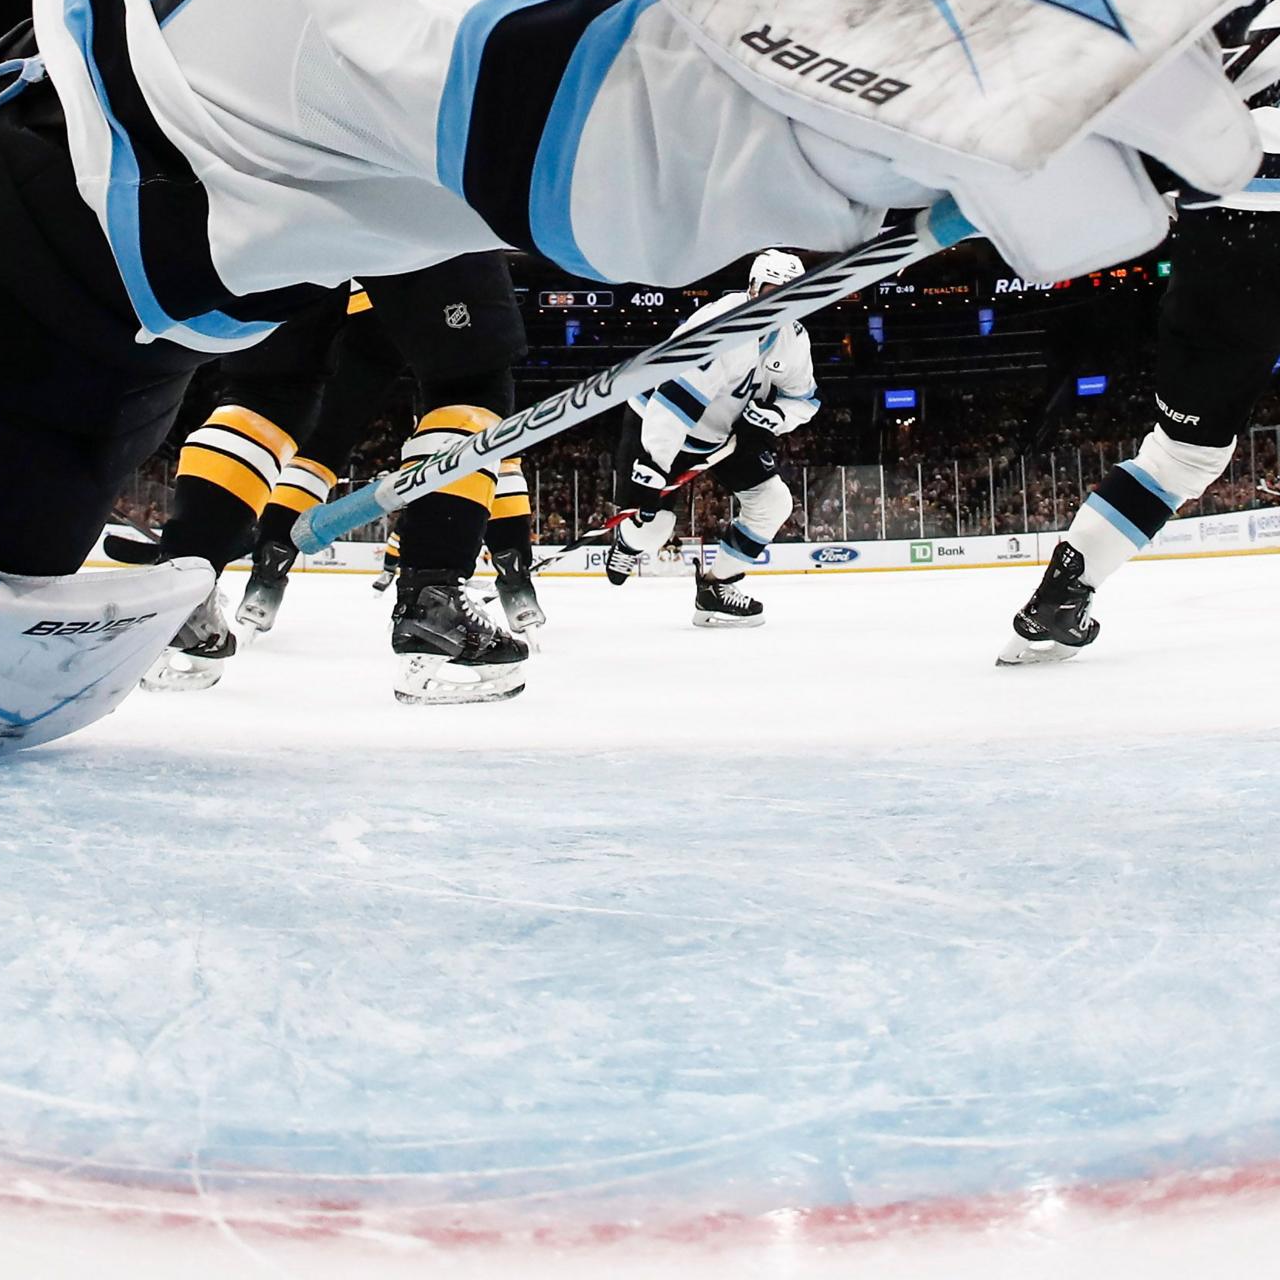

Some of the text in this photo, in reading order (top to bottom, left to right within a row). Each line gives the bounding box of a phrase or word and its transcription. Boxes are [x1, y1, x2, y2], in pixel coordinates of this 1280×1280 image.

[879, 285, 915, 296] 77 0:49
[923, 286, 970, 297] PENALTIES
[586, 293, 598, 308] 0
[631, 292, 665, 308] 4:00
[693, 297, 700, 308] 1
[818, 547, 853, 562] Ford
[937, 545, 966, 557] Bank
